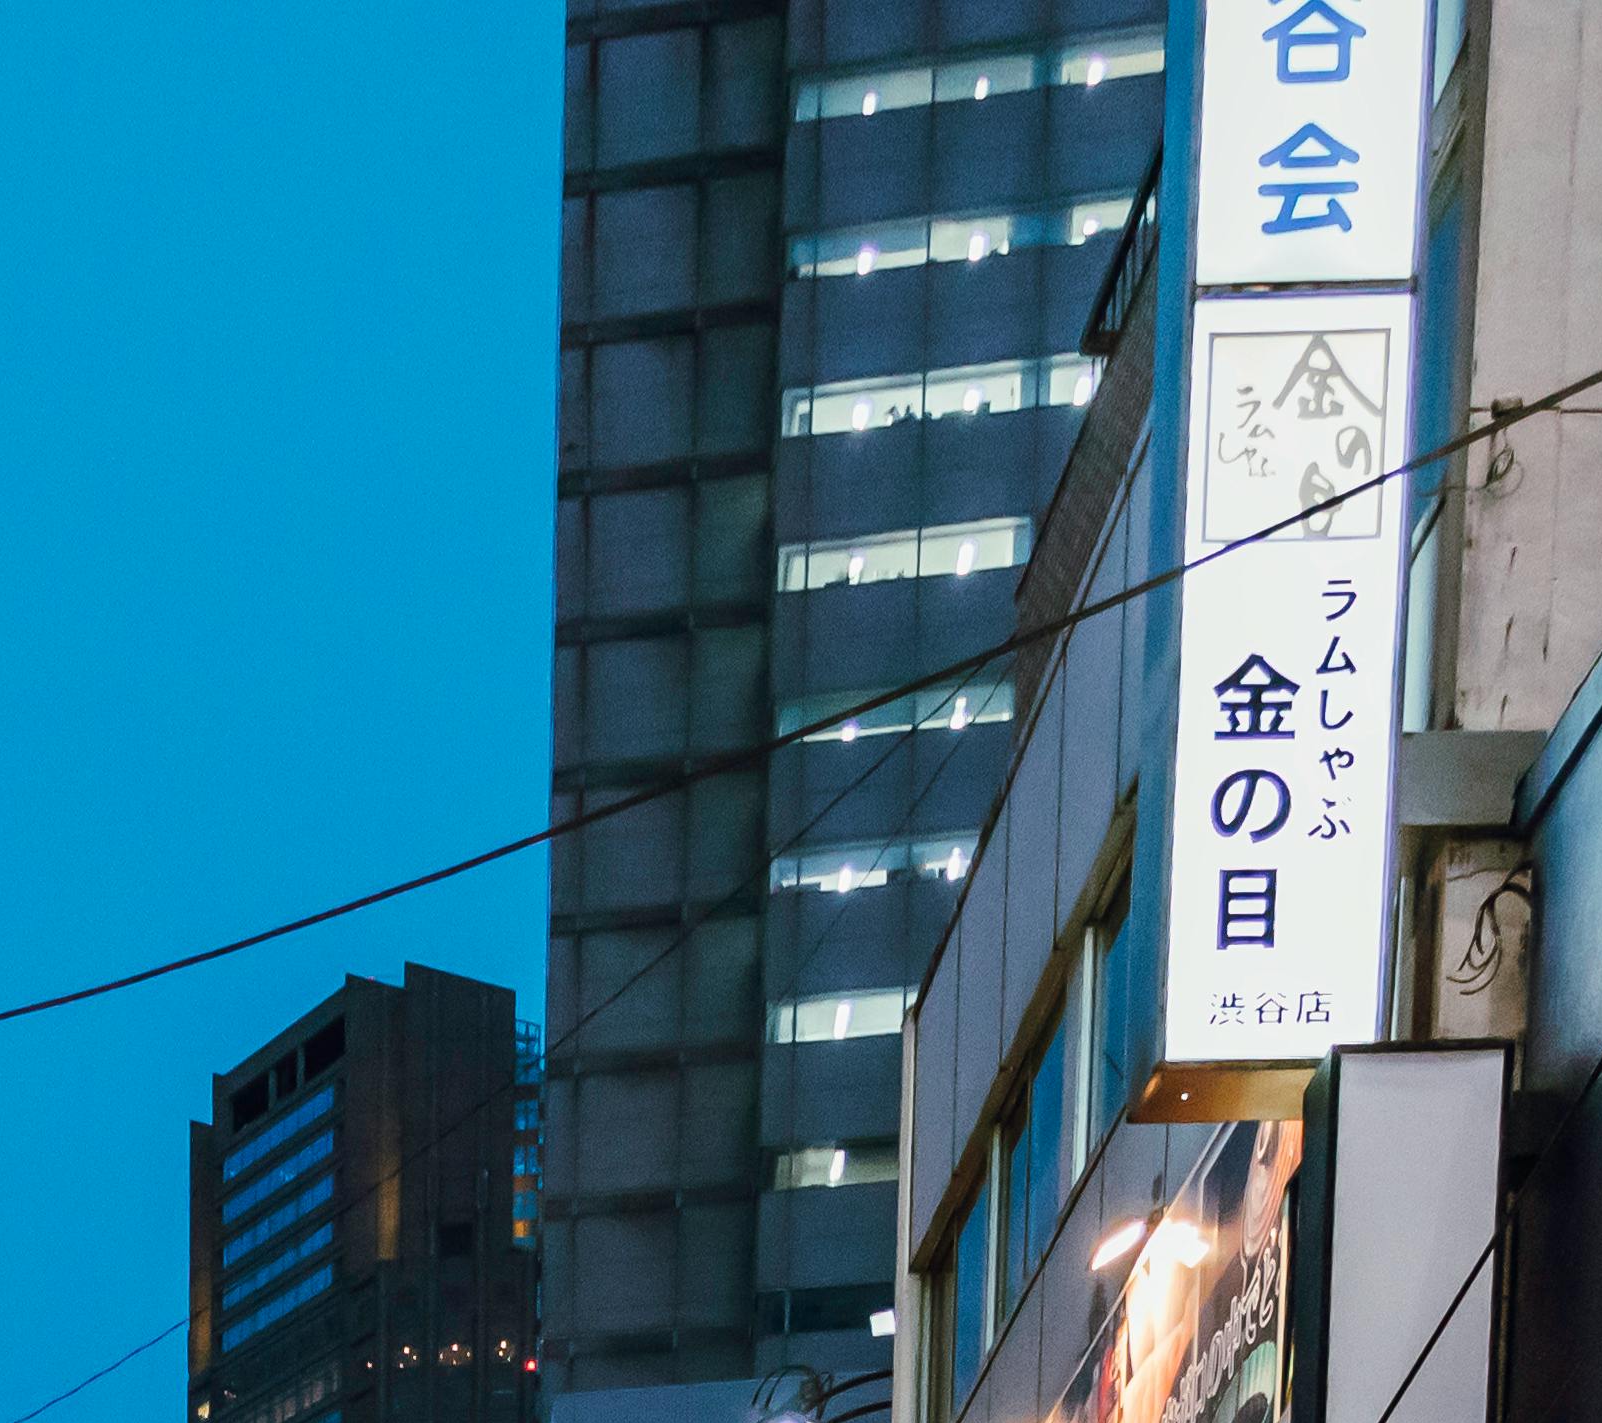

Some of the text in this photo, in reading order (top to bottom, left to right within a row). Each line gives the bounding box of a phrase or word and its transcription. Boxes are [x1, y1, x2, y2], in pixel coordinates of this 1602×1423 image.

[1210, 653, 1302, 951] 金の目
[1307, 579, 1358, 840] ラムしゃぶ
[1209, 990, 1333, 1026] 渋谷店
